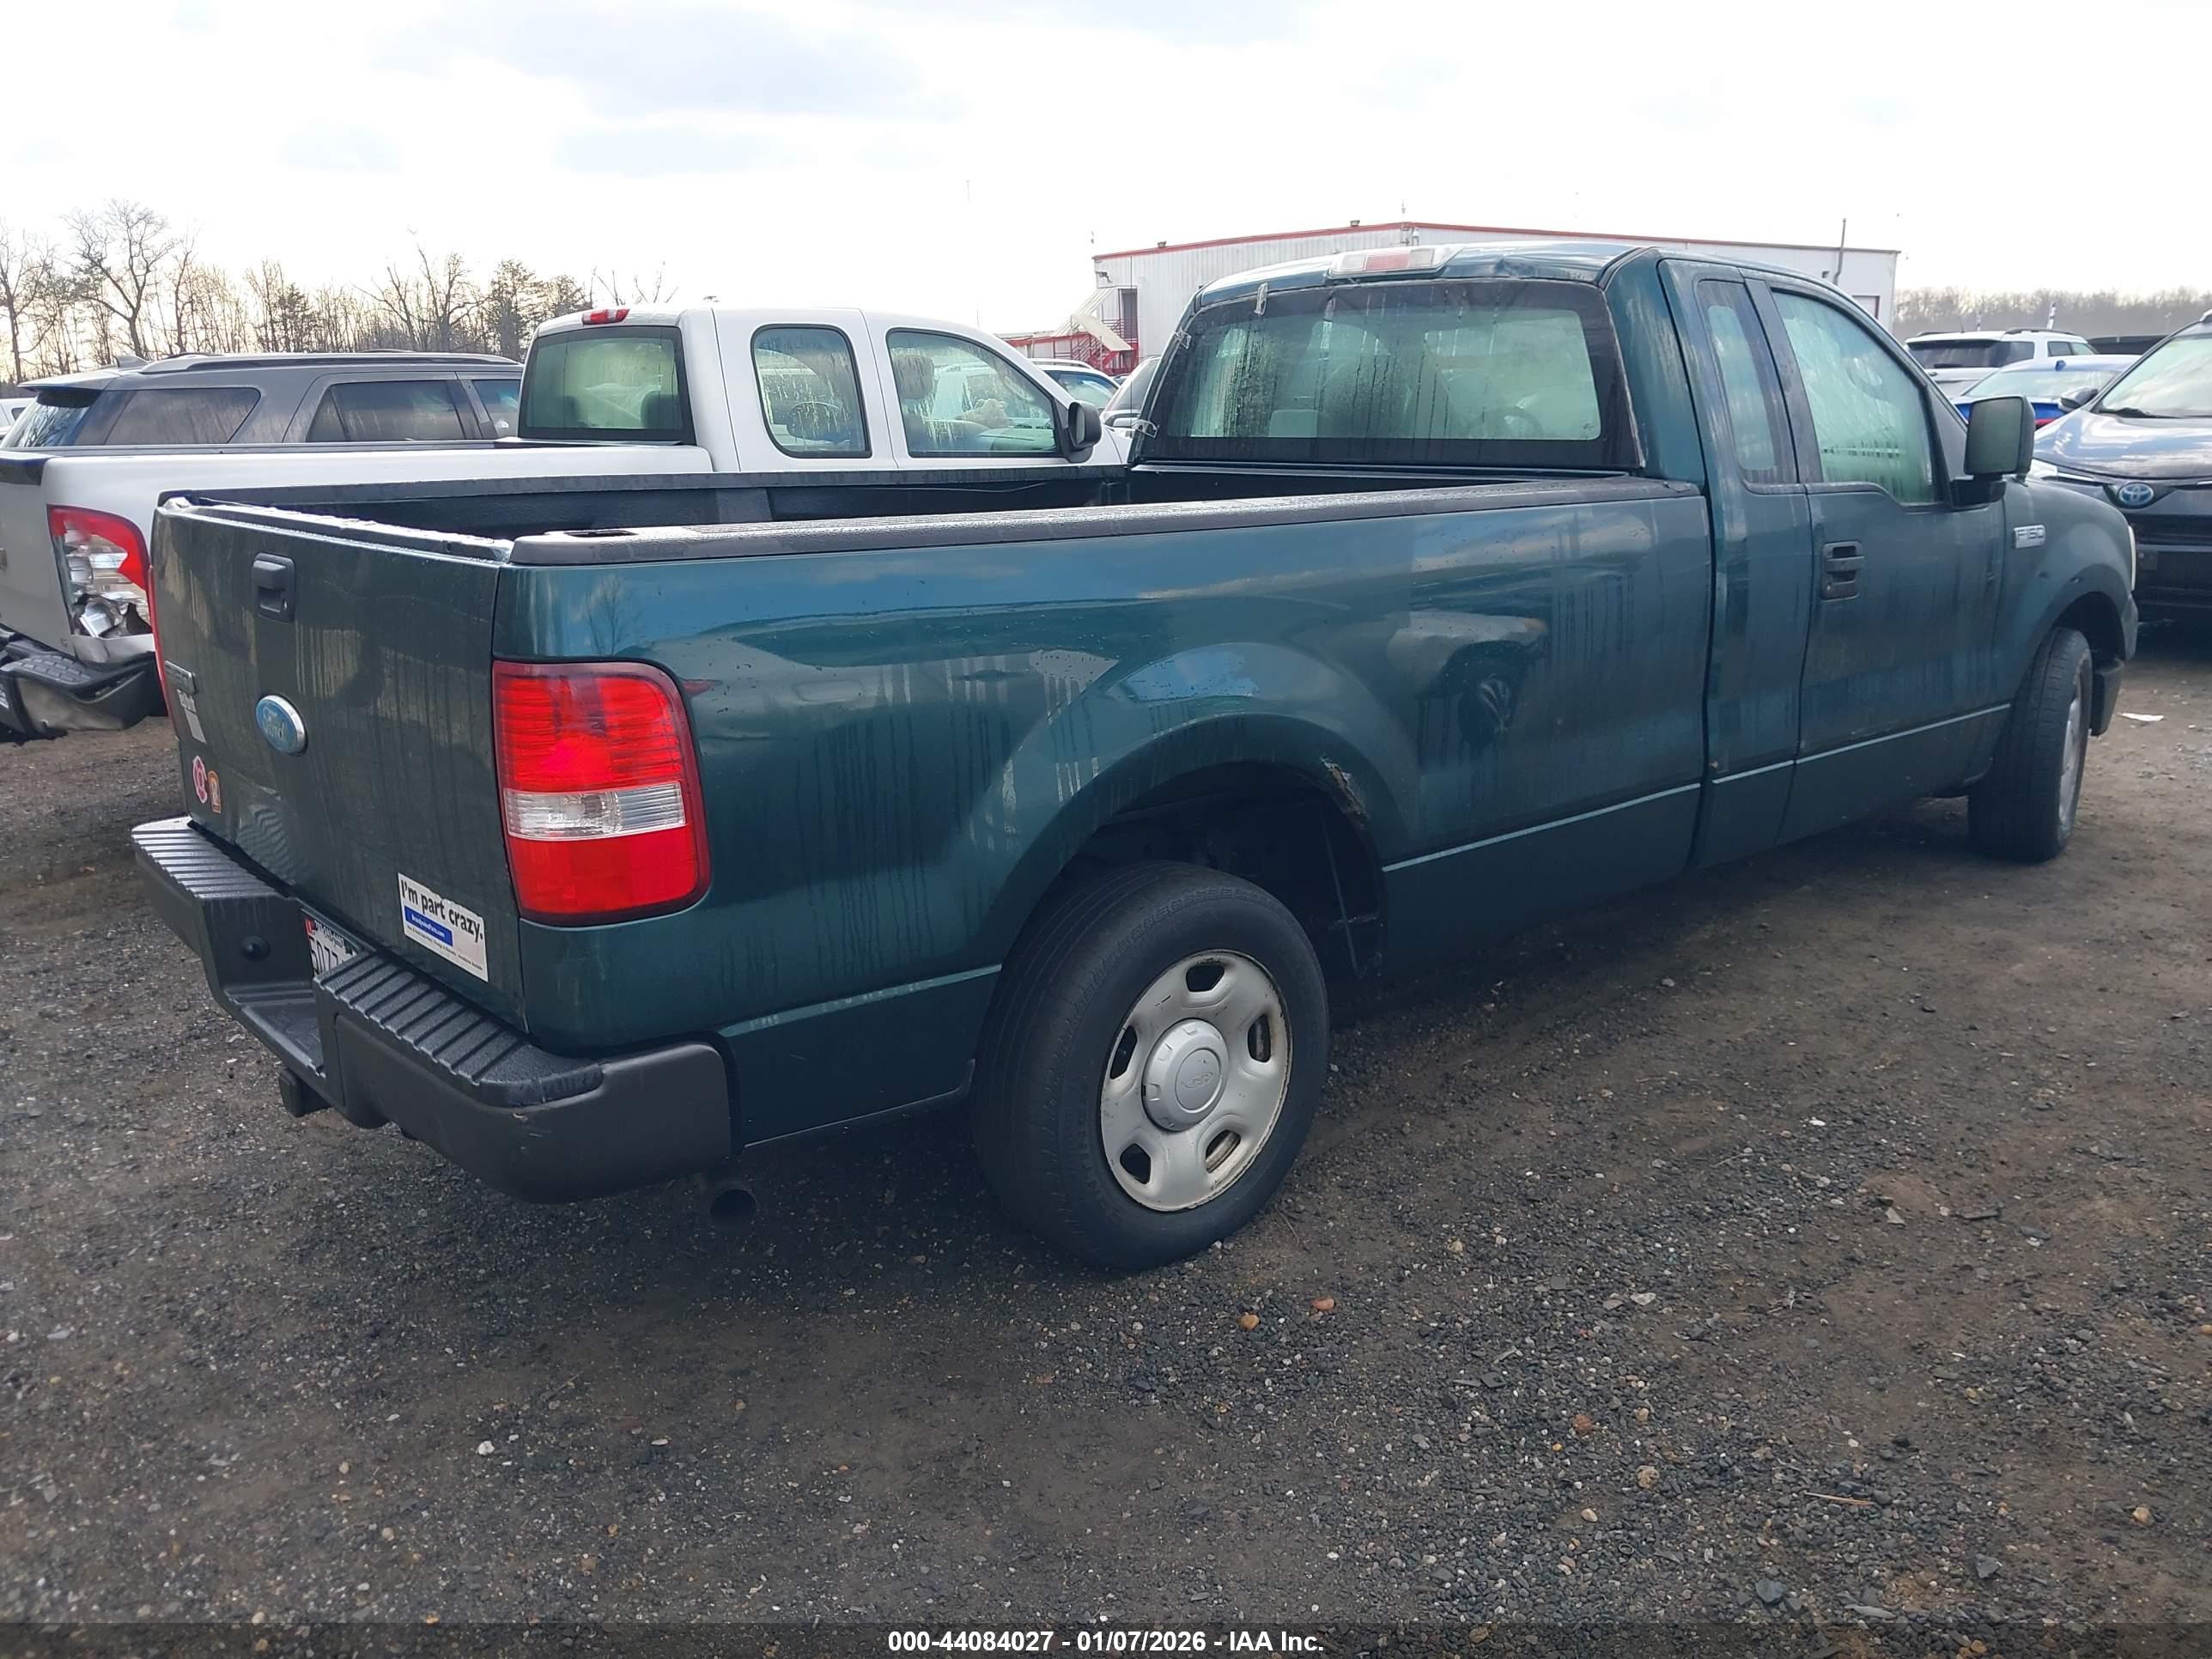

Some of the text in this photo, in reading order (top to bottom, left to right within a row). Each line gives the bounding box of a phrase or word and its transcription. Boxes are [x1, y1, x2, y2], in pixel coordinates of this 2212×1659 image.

[401, 879, 483, 943] I'm part crazy.
